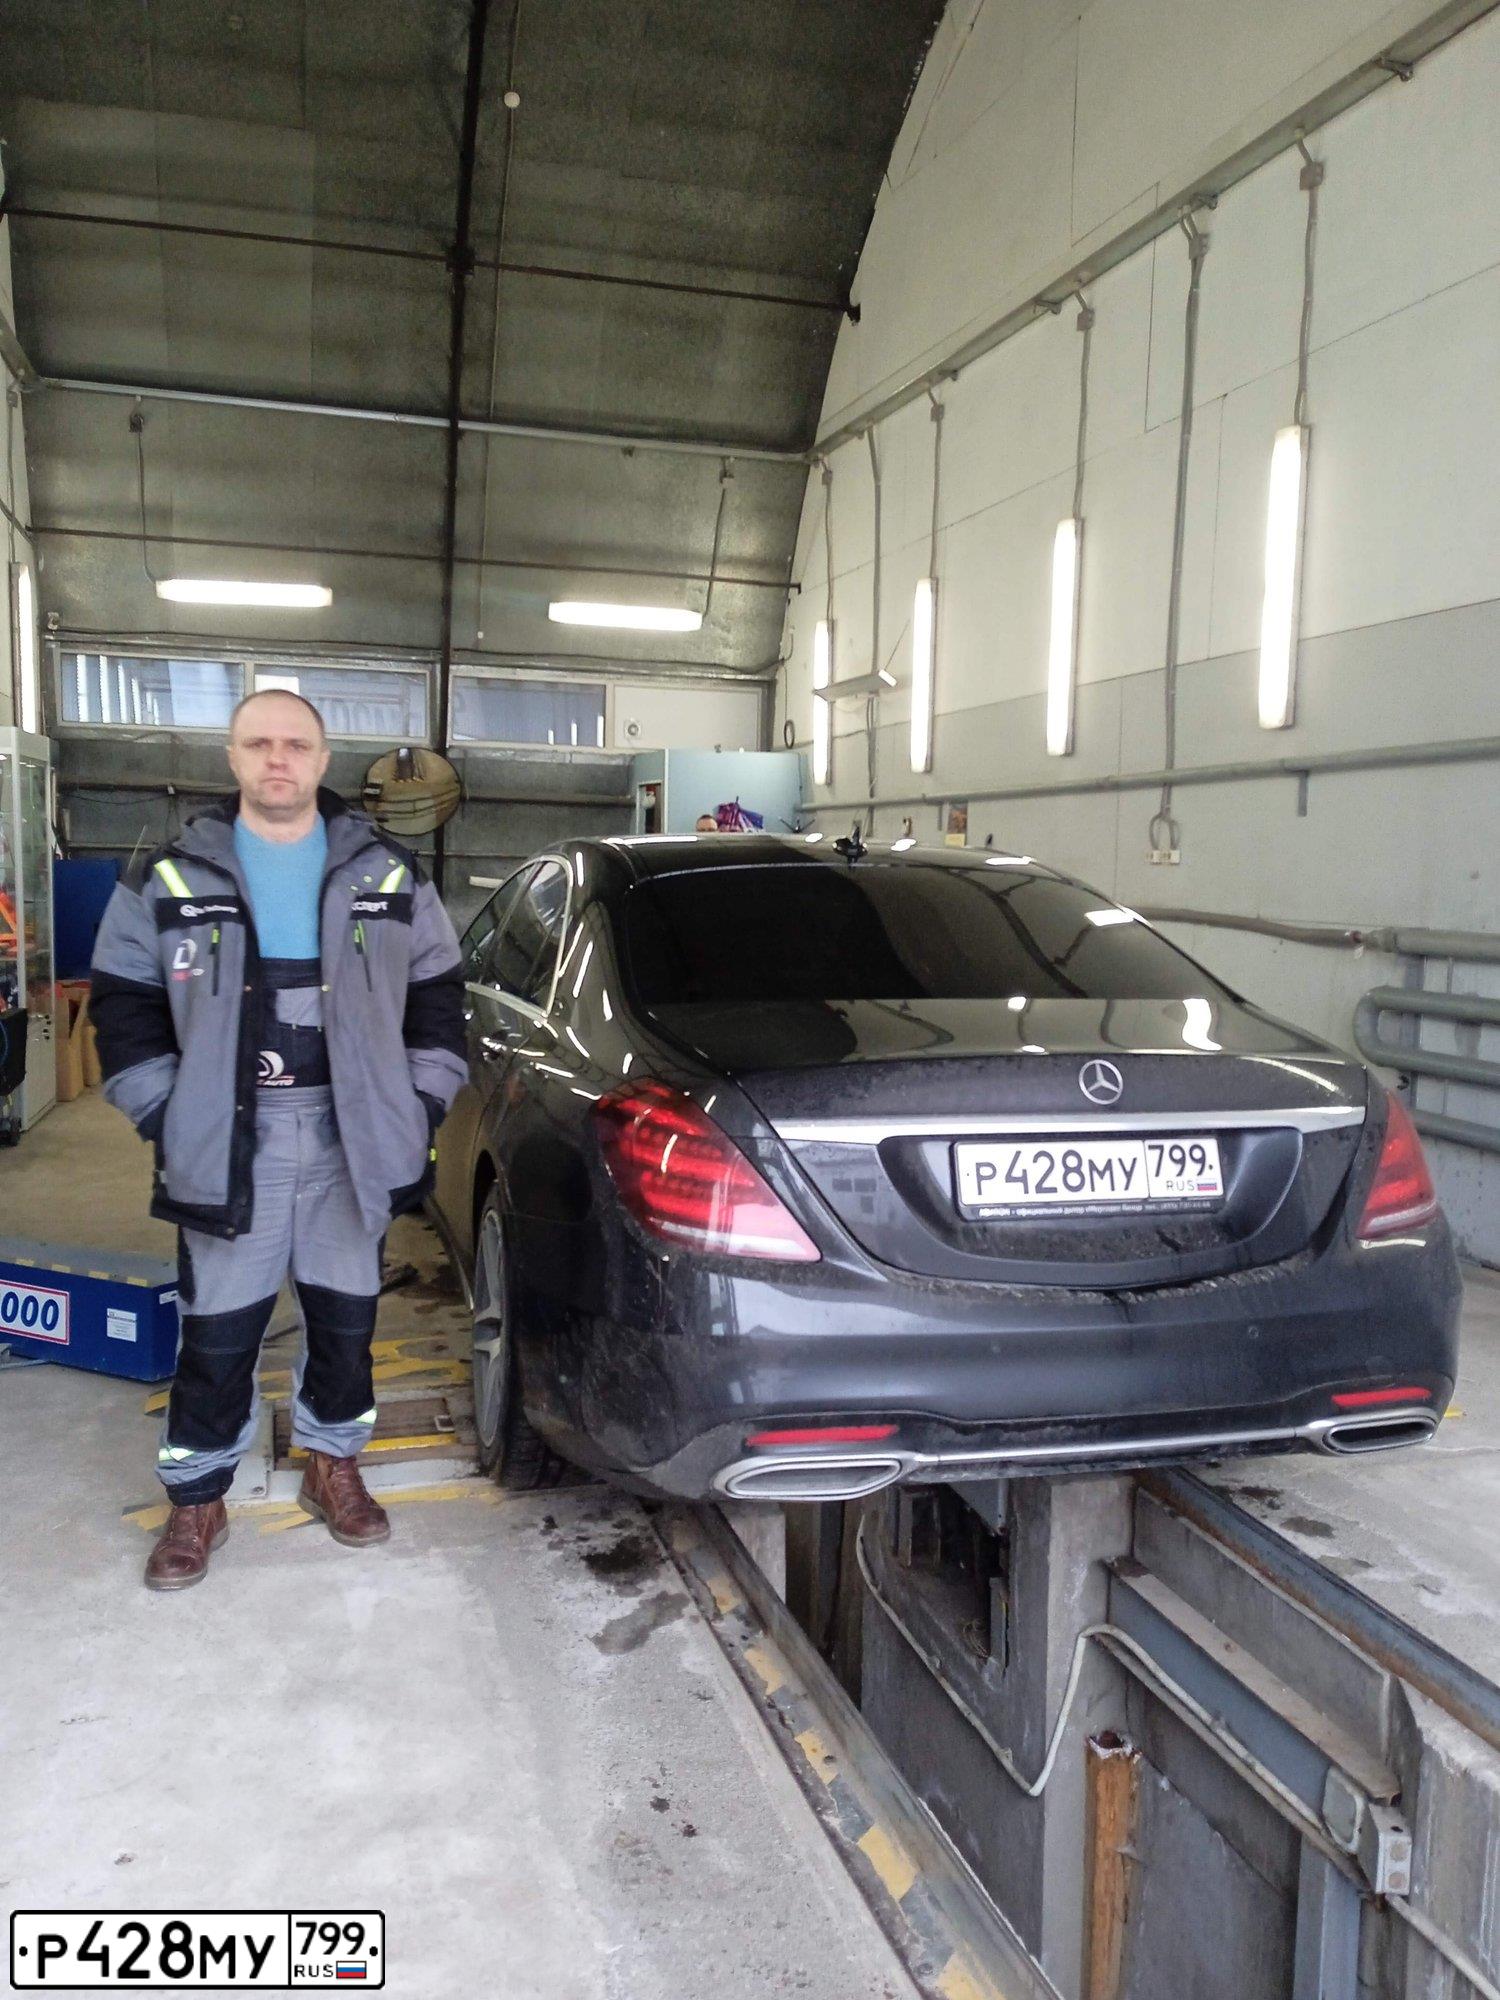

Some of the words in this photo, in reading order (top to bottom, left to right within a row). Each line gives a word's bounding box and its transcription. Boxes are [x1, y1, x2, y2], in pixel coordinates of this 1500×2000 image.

[975, 1149, 1137, 1196] Р428МУ
[1148, 1144, 1207, 1177] 799
[1166, 1180, 1195, 1192] RUS
